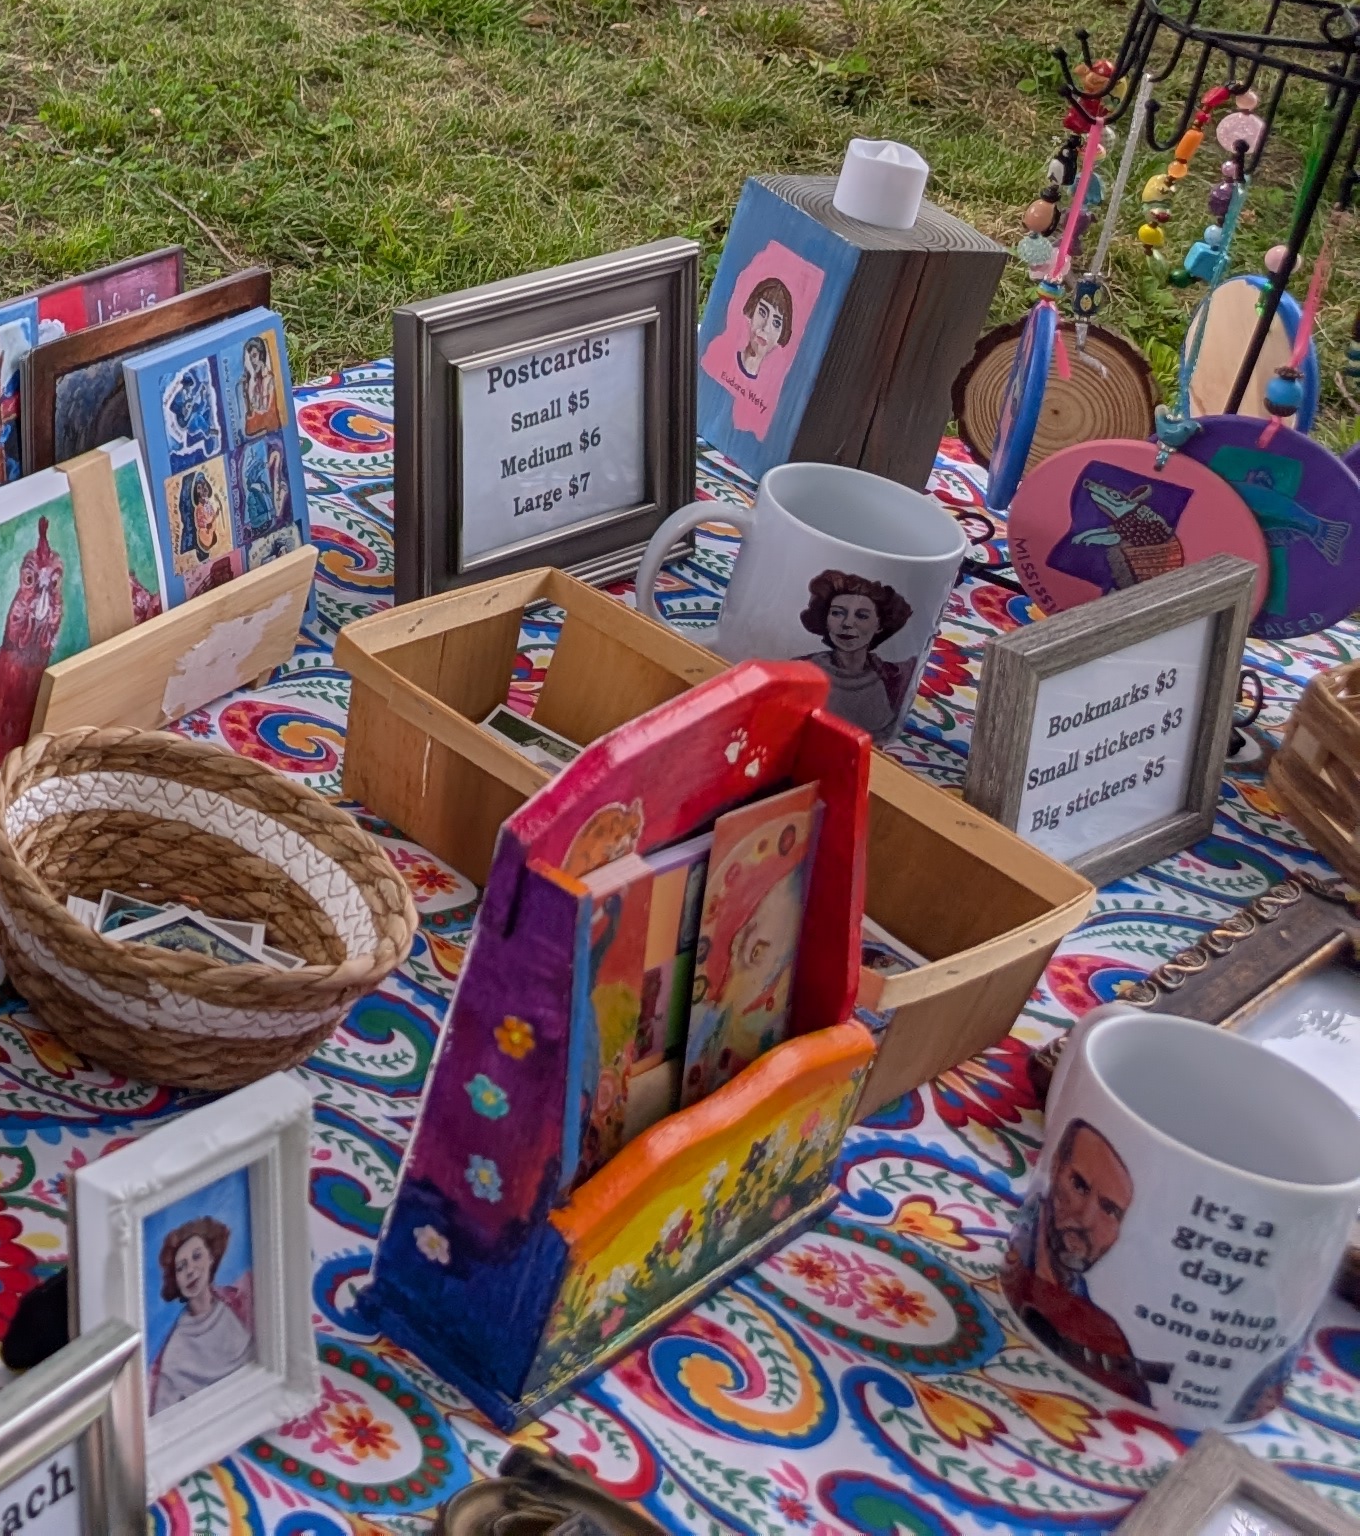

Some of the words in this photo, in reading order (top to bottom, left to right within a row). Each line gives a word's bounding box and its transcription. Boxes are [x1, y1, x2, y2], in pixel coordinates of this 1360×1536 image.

[487, 337, 610, 394] Postcards:
[511, 398, 562, 432] Small
[568, 389, 590, 415] $5
[501, 441, 573, 479] Medium
[579, 426, 601, 453] $6
[513, 487, 562, 517] Large
[569, 472, 591, 498] $7
[1014, 537, 1058, 612] MISSISSI
[1047, 683, 1149, 738] Bookmarks
[1155, 668, 1177, 696] $3
[1026, 749, 1080, 791] Small
[1084, 724, 1155, 766] stickers
[1160, 707, 1183, 735] $3
[1030, 805, 1061, 833] Big
[1066, 773, 1137, 817] stickers
[1143, 755, 1165, 784] $5
[1191, 1195, 1246, 1231] It's
[1253, 1220, 1274, 1239] a
[1172, 1225, 1270, 1267] great
[1180, 1259, 1244, 1295] day
[1135, 1304, 1287, 1353] somebody's
[1171, 1293, 1198, 1314] to
[1210, 1308, 1277, 1331] whup
[1186, 1349, 1232, 1369] ass
